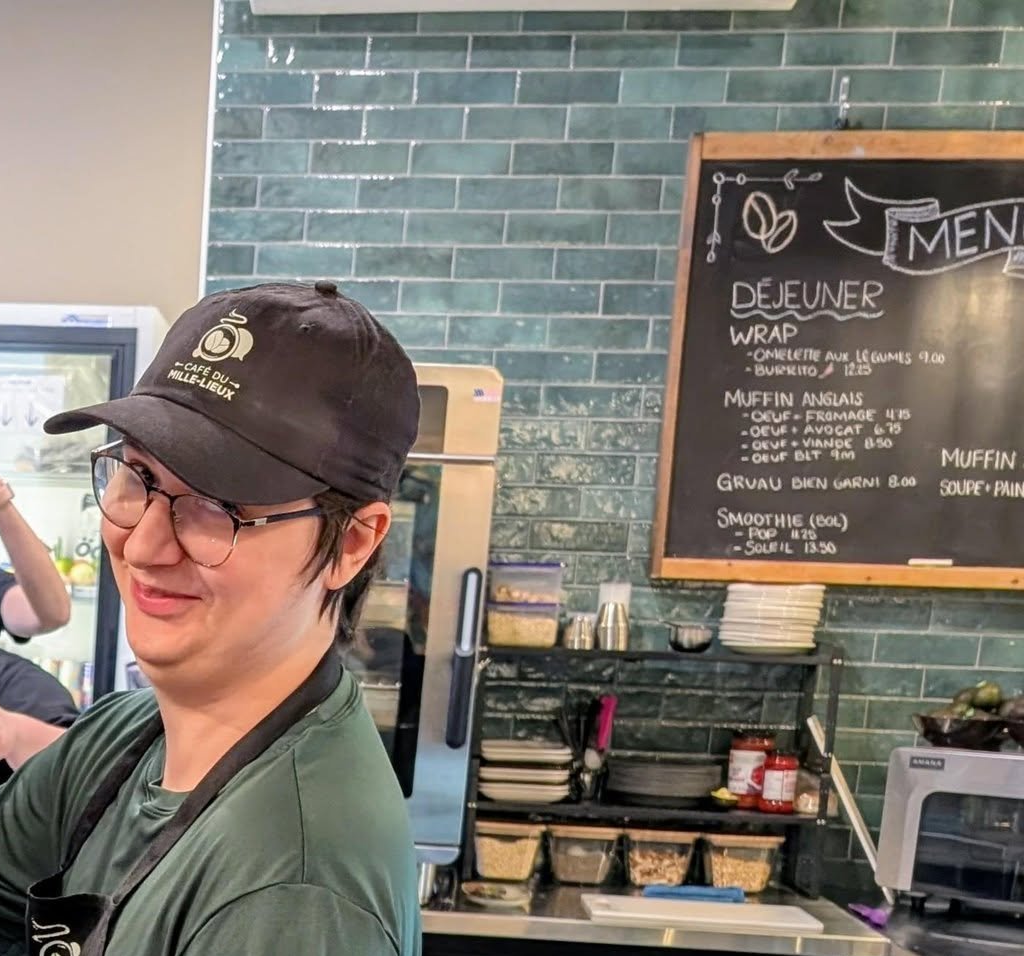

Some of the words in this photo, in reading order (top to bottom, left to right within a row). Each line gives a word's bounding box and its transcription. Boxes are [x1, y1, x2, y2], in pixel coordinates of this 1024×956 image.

[908, 205, 1024, 261] MEN
[732, 277, 884, 310] DÉJEUNER
[730, 322, 798, 345] WRAP
[825, 349, 849, 362] AUX
[184, 362, 212, 376] CAFÉ
[212, 371, 229, 383] DU
[754, 364, 818, 377] BURRITO
[167, 369, 235, 400] MILLE-LIEUX
[724, 388, 794, 408] MUFFIN
[802, 391, 864, 407] ANGLAIS
[751, 409, 792, 423] OEUF
[805, 408, 877, 422] FROMAGE
[750, 424, 788, 438] OEUF
[803, 424, 864, 435] AVOCAT
[751, 438, 788, 451] OEUF
[802, 437, 854, 449] VIANDE
[751, 451, 787, 464] OEUF
[794, 450, 822, 462] BLT
[941, 447, 1017, 470] MUFFIN
[717, 472, 782, 492] GRUAU
[791, 475, 827, 490] BIEN
[833, 475, 880, 490] GARNI
[939, 478, 985, 497] SOUPE
[717, 507, 804, 528] SMOOTHIE
[749, 527, 778, 540] POP
[744, 540, 794, 556] SOLEIL
